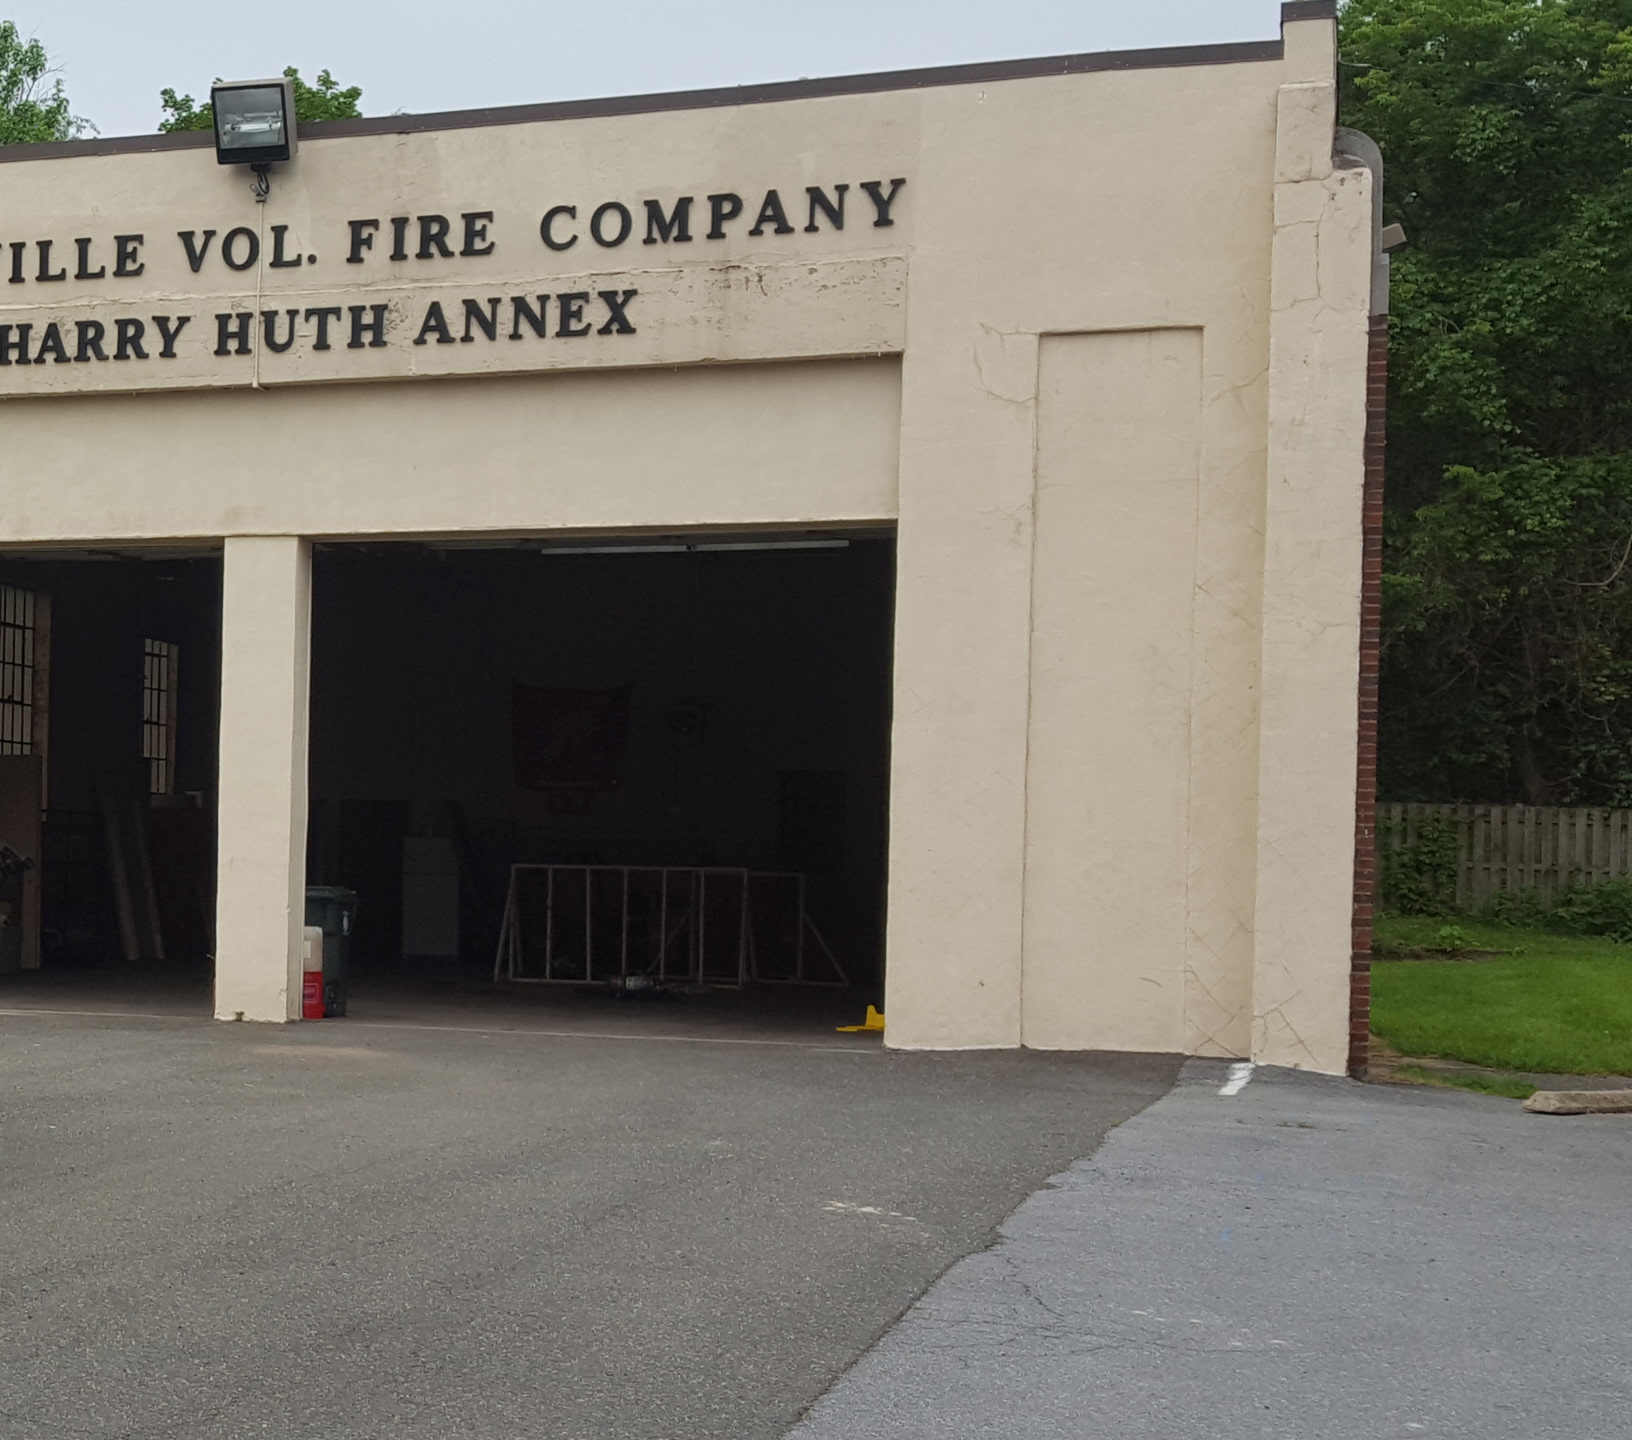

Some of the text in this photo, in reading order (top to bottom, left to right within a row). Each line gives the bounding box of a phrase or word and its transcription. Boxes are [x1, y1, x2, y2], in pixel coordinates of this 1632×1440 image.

[177, 224, 317, 273] VOL.
[346, 211, 496, 264] FIRE
[540, 177, 907, 251] COMPANY
[213, 304, 389, 356] HUTH
[412, 289, 638, 345] ANNEX
